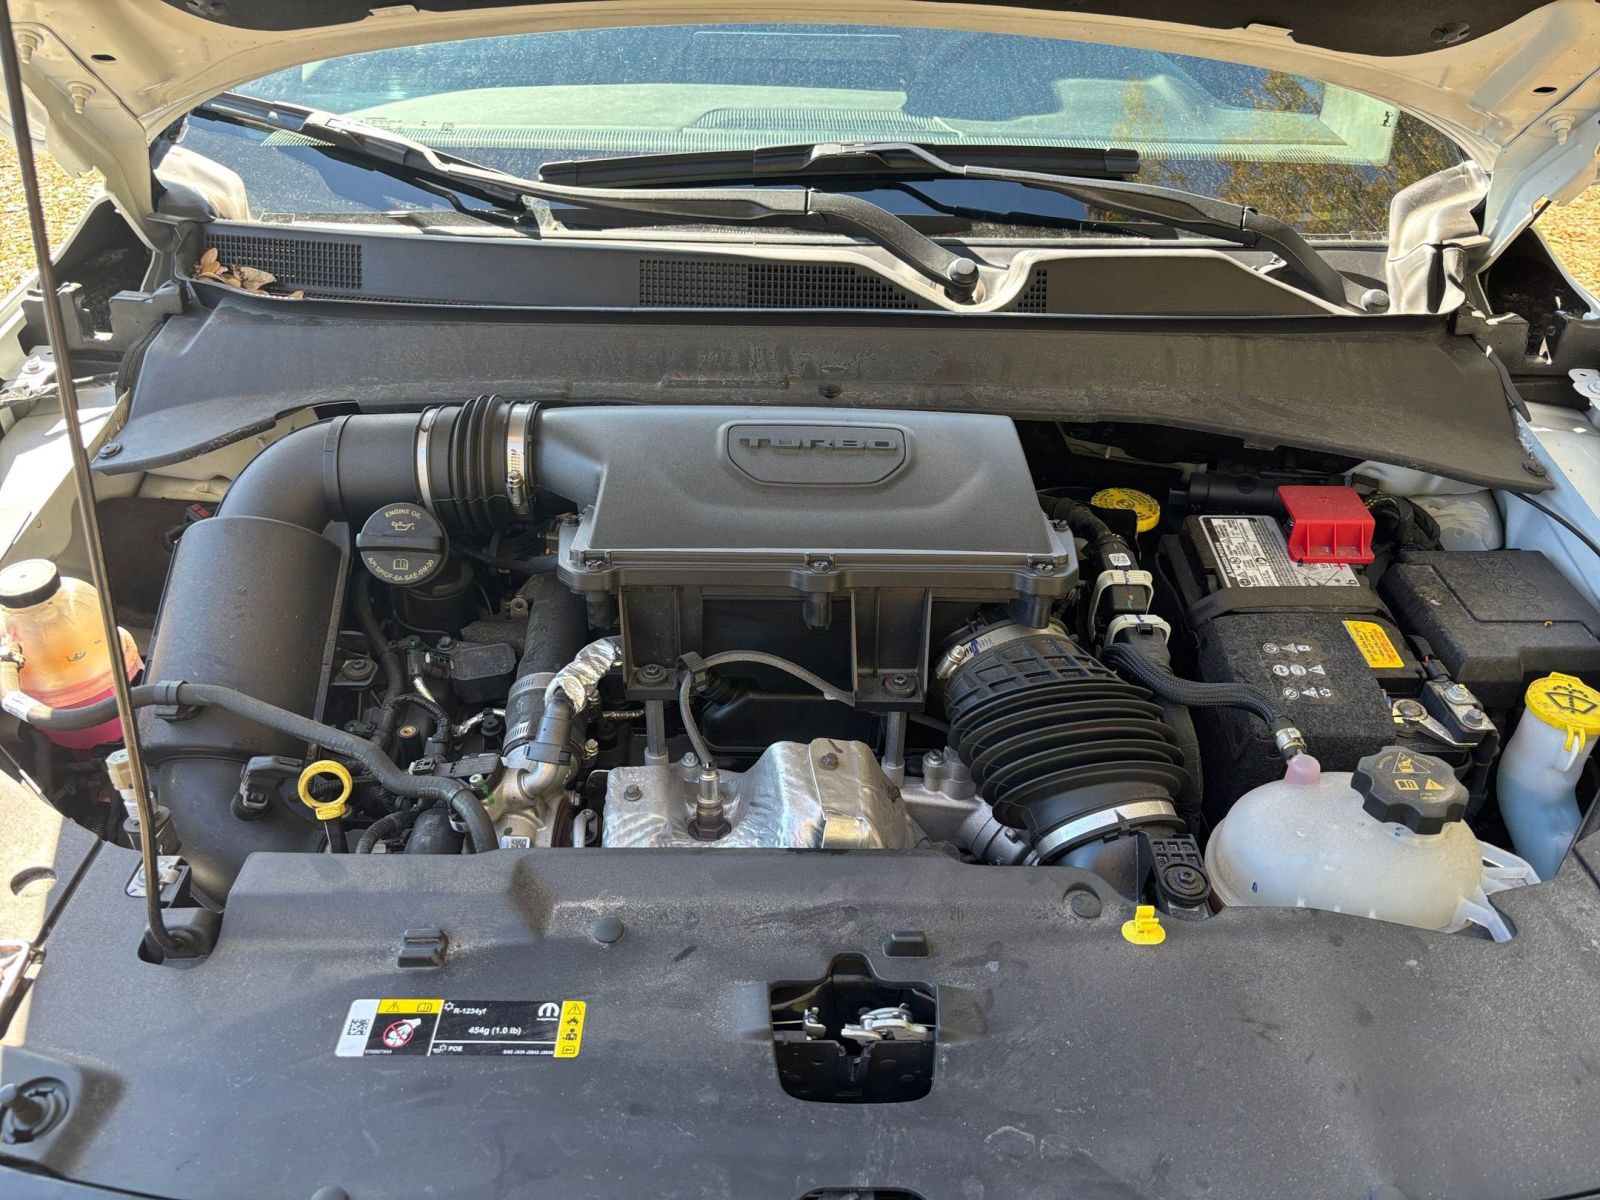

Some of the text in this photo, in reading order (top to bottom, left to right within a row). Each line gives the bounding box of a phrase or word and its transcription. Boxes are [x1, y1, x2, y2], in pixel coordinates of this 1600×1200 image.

[739, 437, 897, 450] TURBO
[385, 508, 421, 519] ENGINE OIL
[453, 1007, 487, 1015] R-1234yf
[468, 1026, 522, 1036] 454g (1.0 lb)
